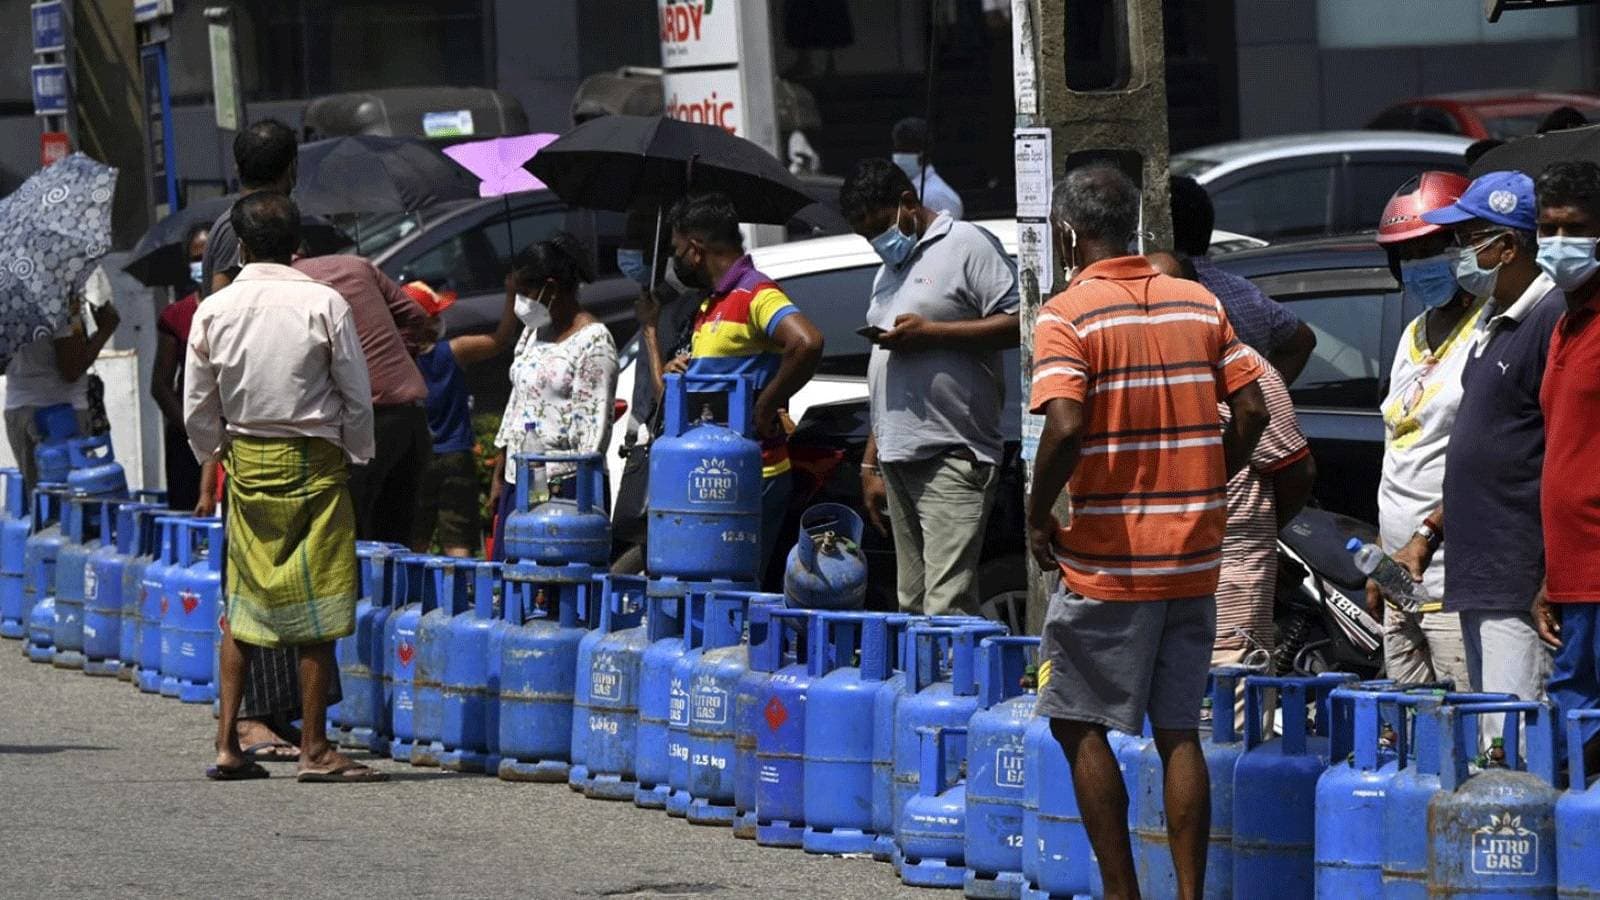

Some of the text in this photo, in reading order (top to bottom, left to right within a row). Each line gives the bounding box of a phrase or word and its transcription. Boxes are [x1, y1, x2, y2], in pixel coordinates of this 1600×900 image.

[695, 477, 732, 489] LITRO
[699, 489, 726, 500] GAS
[1330, 591, 1361, 620] YBR
[711, 755, 726, 770] kg
[1007, 834, 1024, 847] 12
[1481, 838, 1530, 855] LITRO
[1486, 854, 1523, 869] GAS
